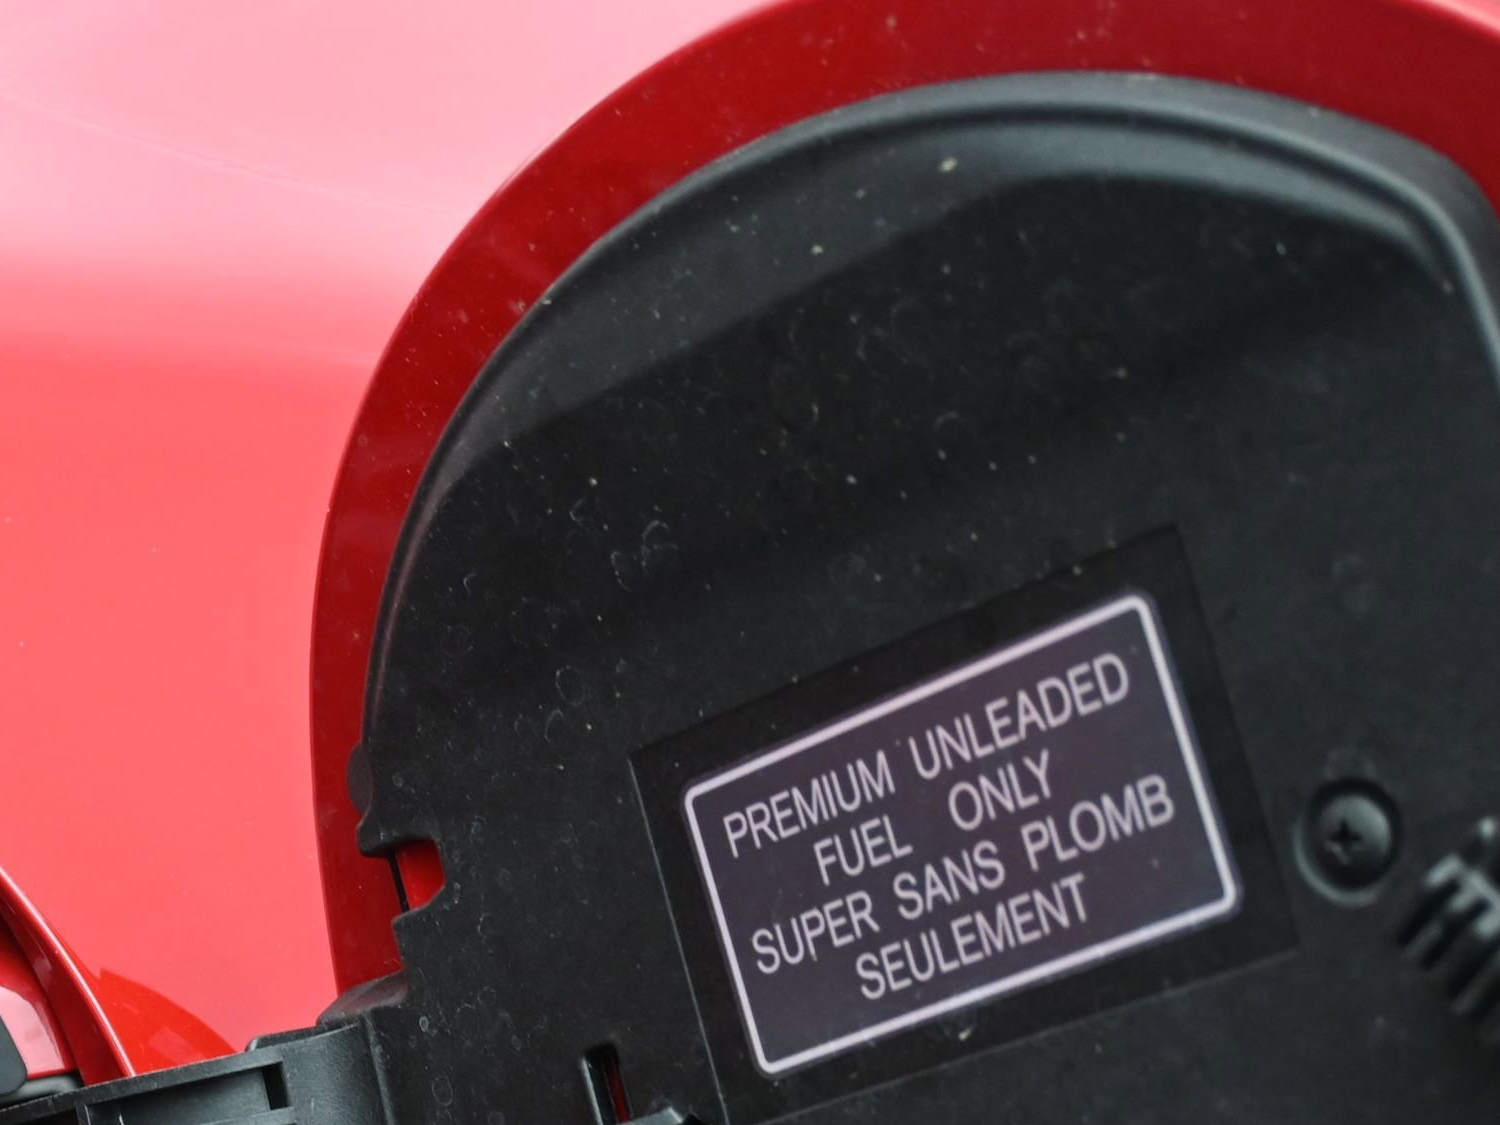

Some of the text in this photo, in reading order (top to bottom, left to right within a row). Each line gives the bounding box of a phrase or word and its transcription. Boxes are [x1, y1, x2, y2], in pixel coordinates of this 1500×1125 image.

[723, 653, 1129, 858] PREMIUM UNLEADED
[813, 749, 1053, 885] FUEL ONLY
[752, 775, 1174, 974] SUPER SANS PLOMB
[856, 874, 1088, 1000] SEULEMENT
